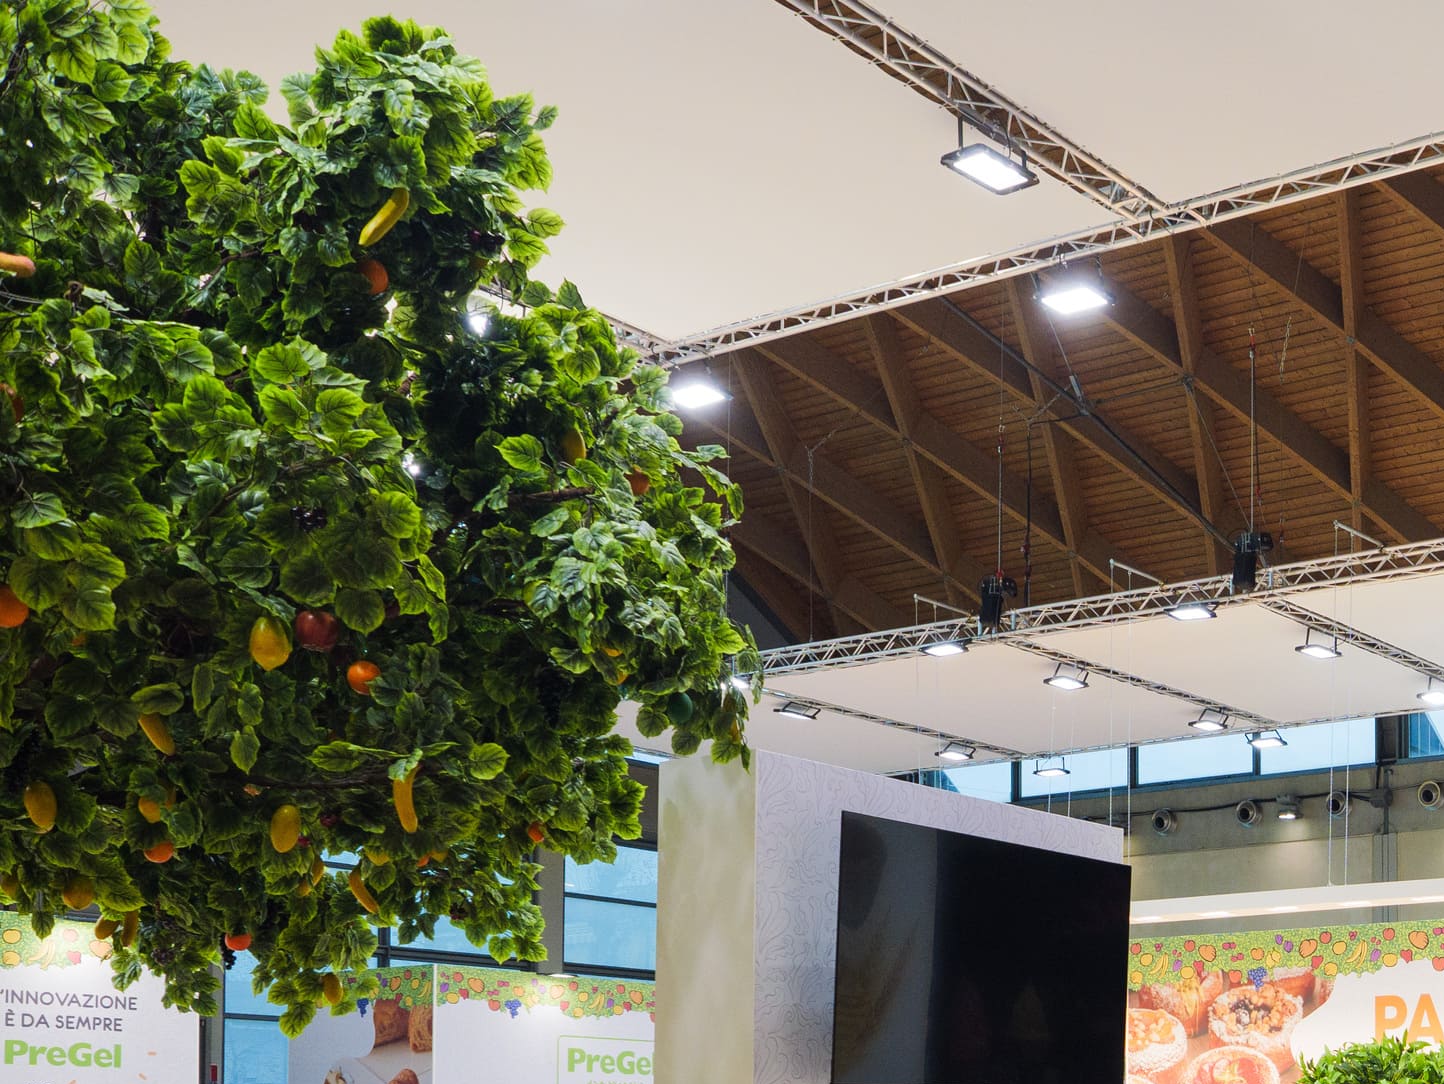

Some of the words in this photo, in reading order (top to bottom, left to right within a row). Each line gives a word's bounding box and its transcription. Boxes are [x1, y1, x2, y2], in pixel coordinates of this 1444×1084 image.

[0, 989, 138, 1011] 'INNOVAZIONE
[5, 1009, 15, 1027] È
[21, 1013, 50, 1028] DA
[55, 1015, 123, 1032] SEMPRE
[4, 1040, 122, 1068] PreGel
